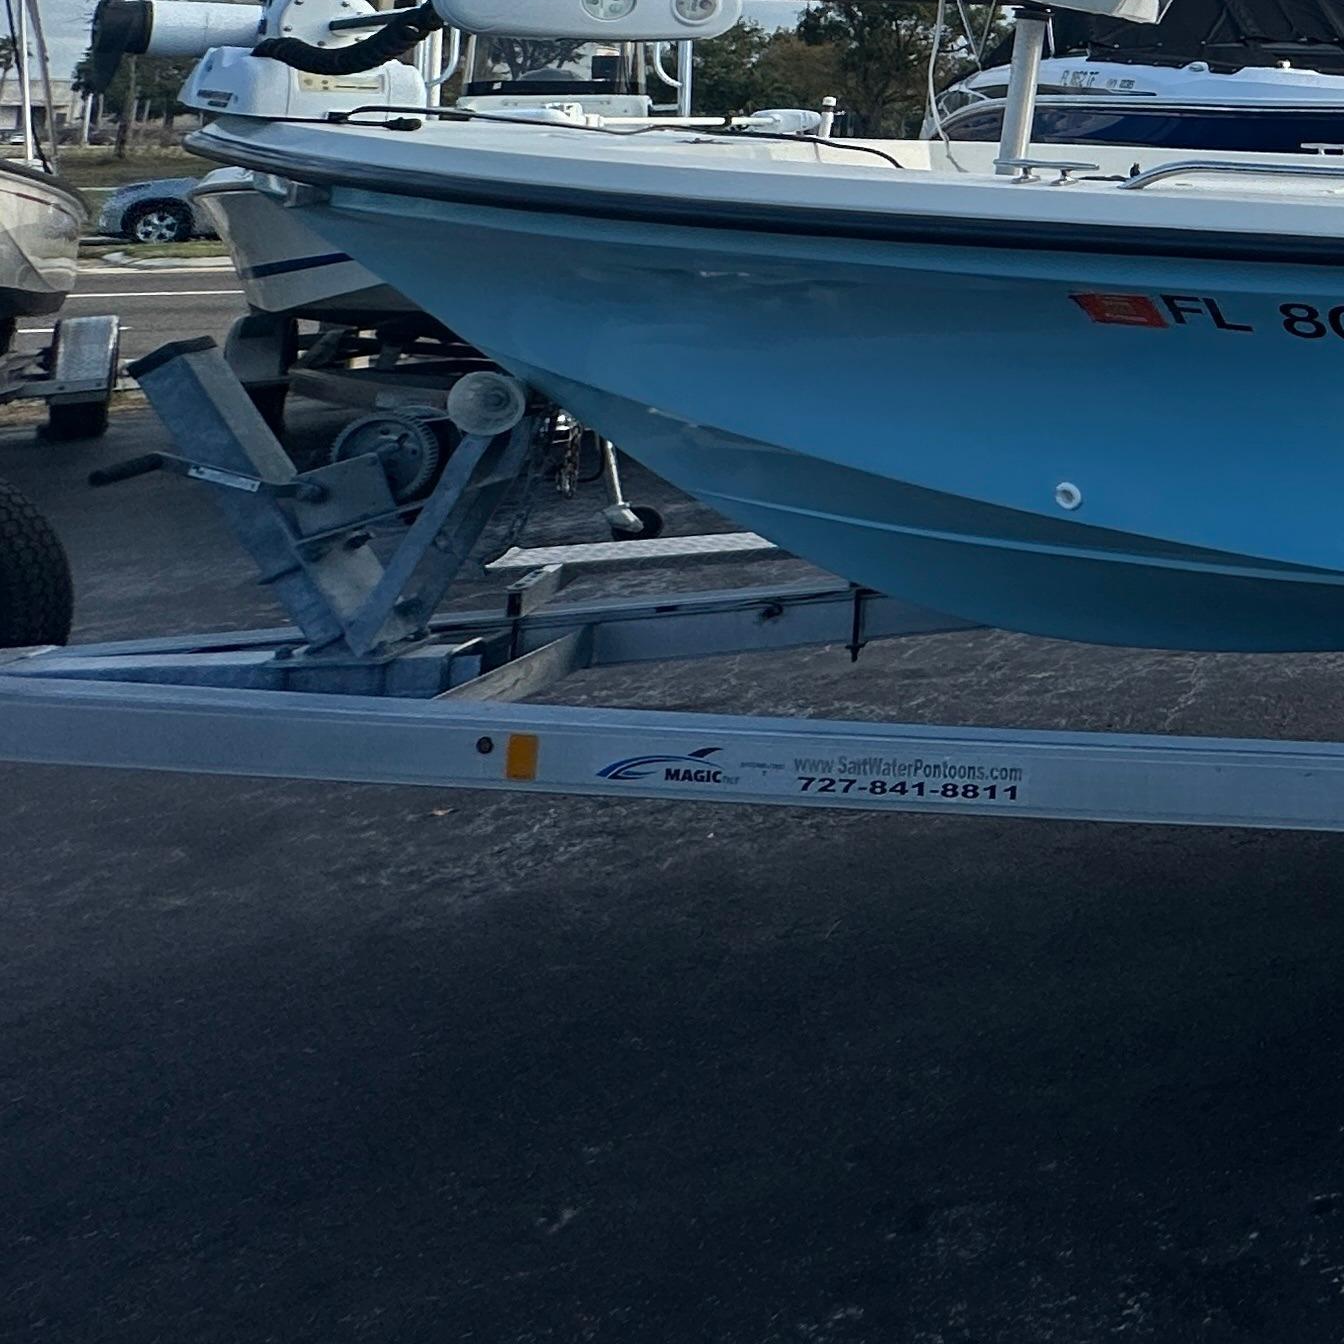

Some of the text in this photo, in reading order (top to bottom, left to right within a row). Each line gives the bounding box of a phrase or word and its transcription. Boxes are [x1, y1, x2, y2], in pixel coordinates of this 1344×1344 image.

[1160, 294, 1254, 333] FL
[664, 768, 722, 784] MAGIC
[797, 776, 1018, 801] 727-841-8811
